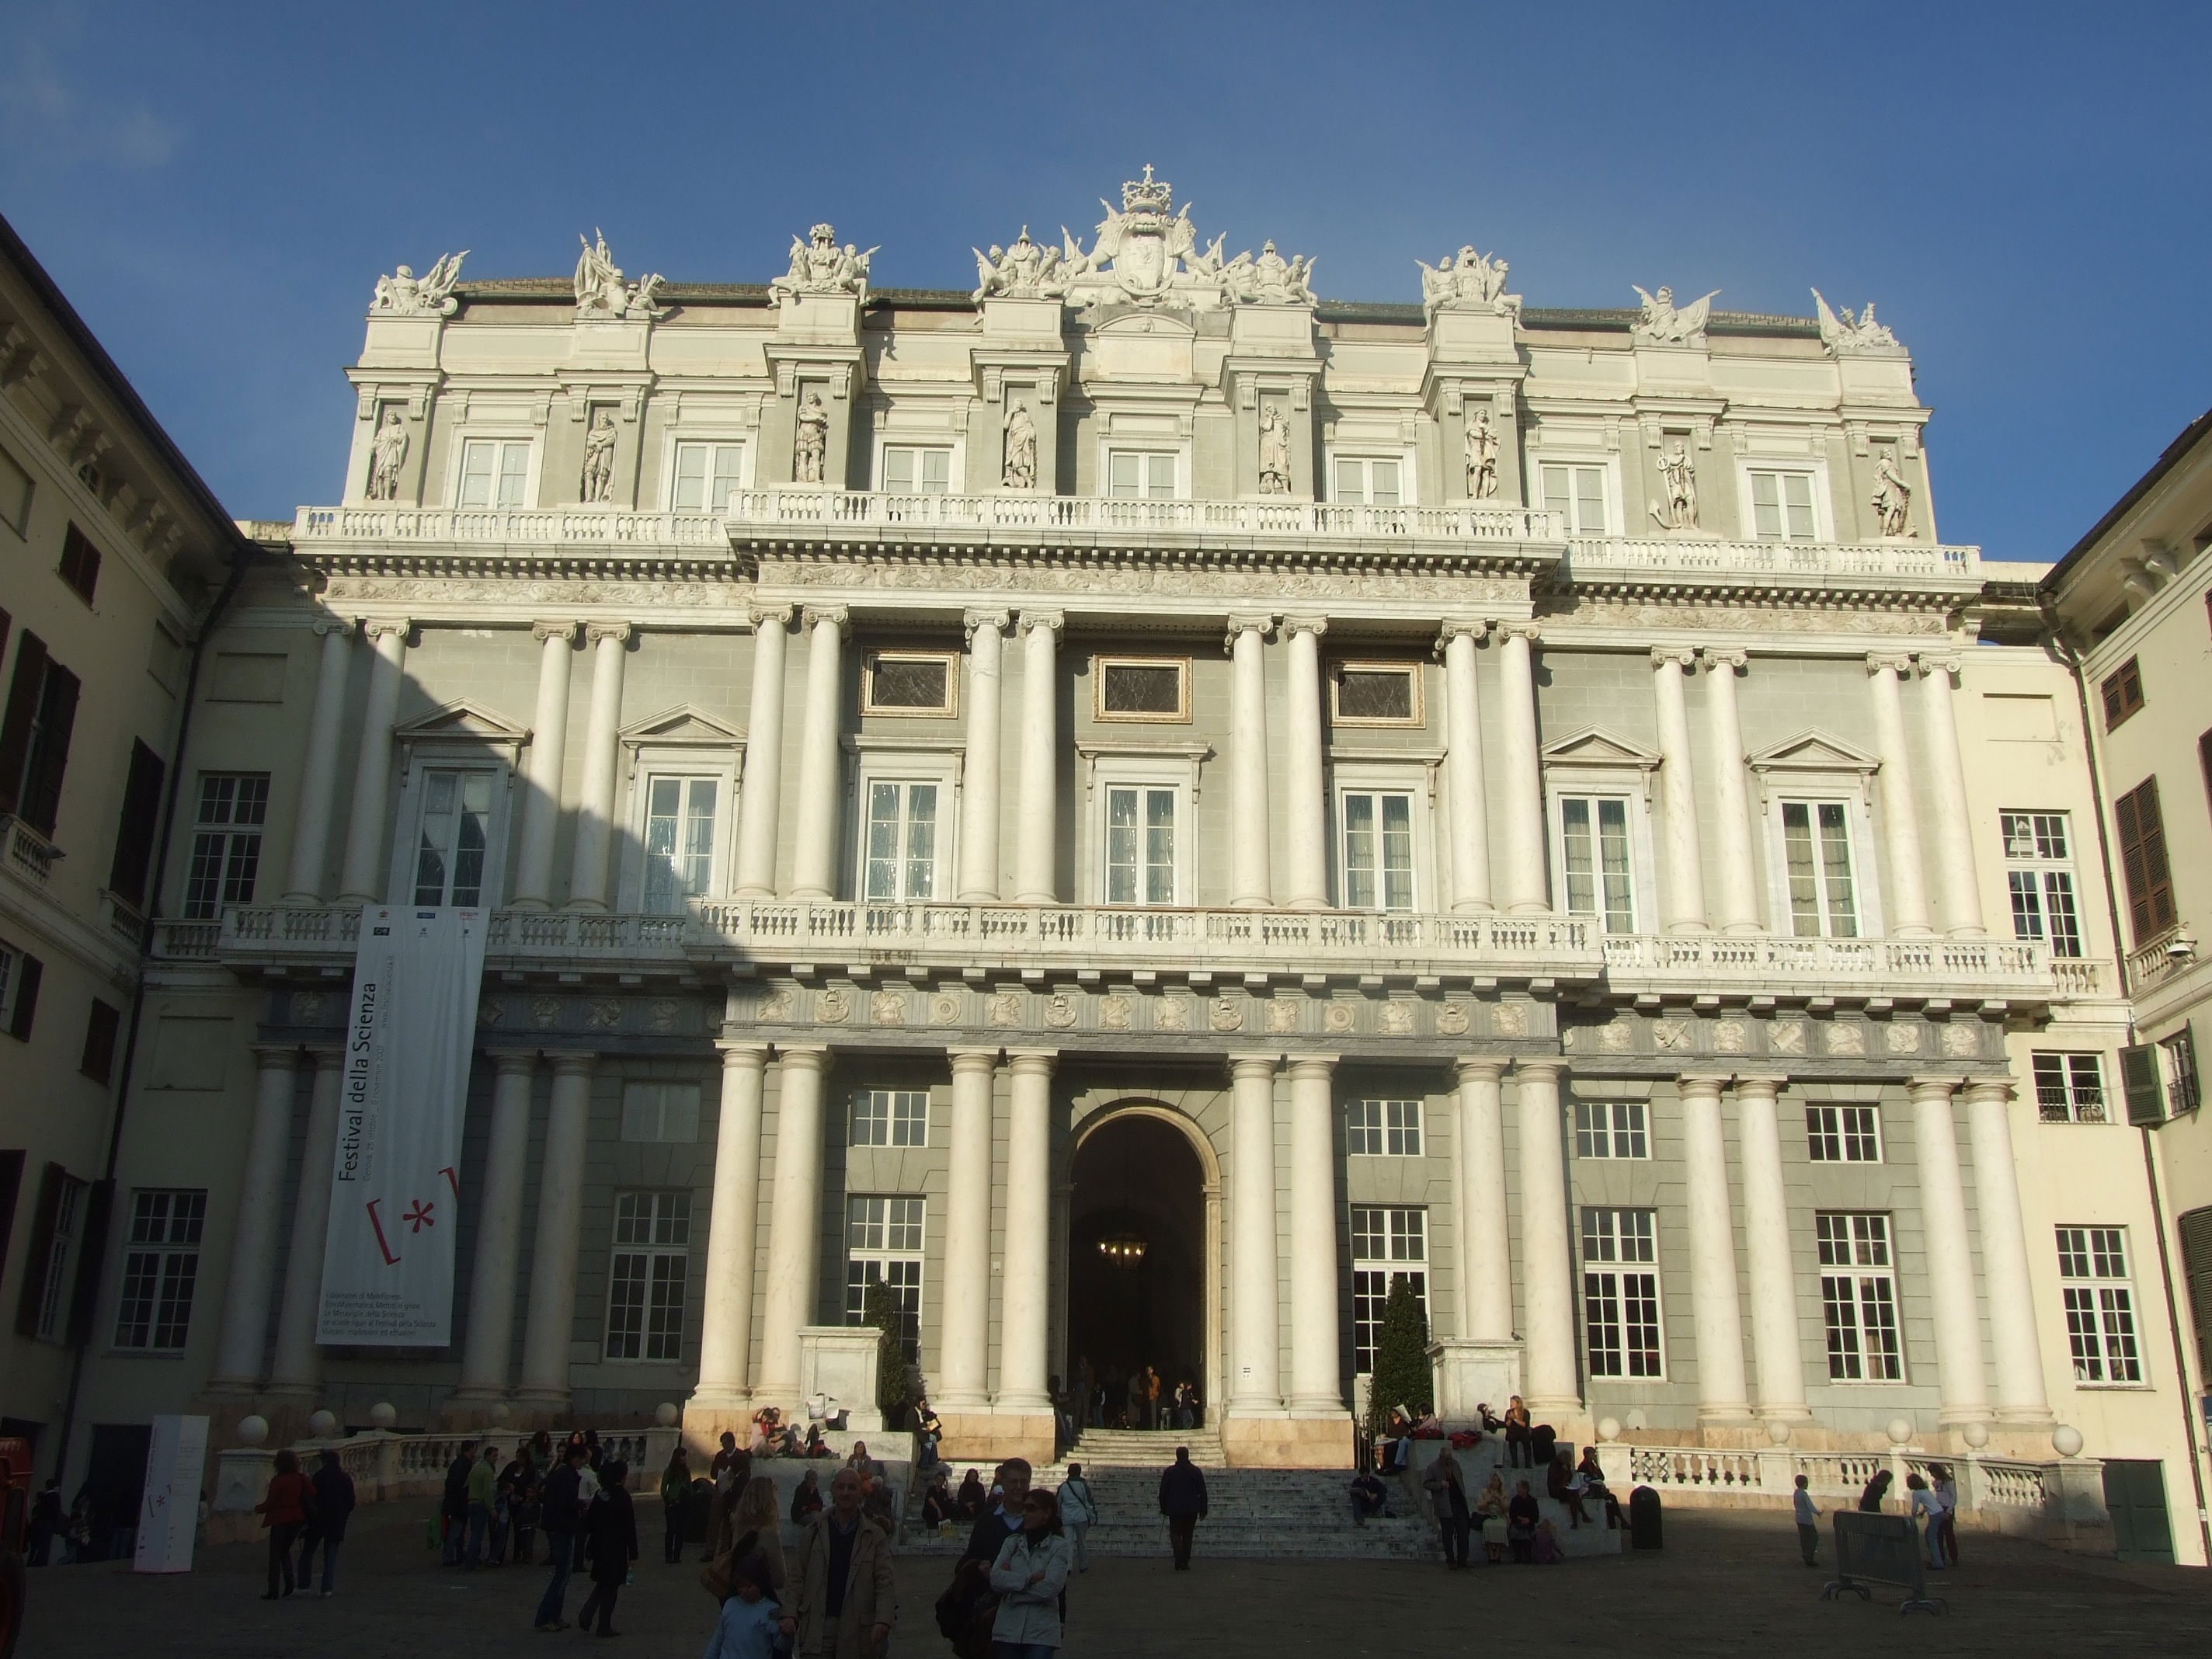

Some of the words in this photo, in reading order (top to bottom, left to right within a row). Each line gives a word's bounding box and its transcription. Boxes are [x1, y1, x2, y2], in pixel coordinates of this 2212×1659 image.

[353, 983, 376, 1052] Scienza
[349, 1059, 368, 1103] della
[372, 1064, 382, 1098] novembre
[339, 1110, 363, 1181] Festival
[368, 1114, 377, 1139] ottobre
